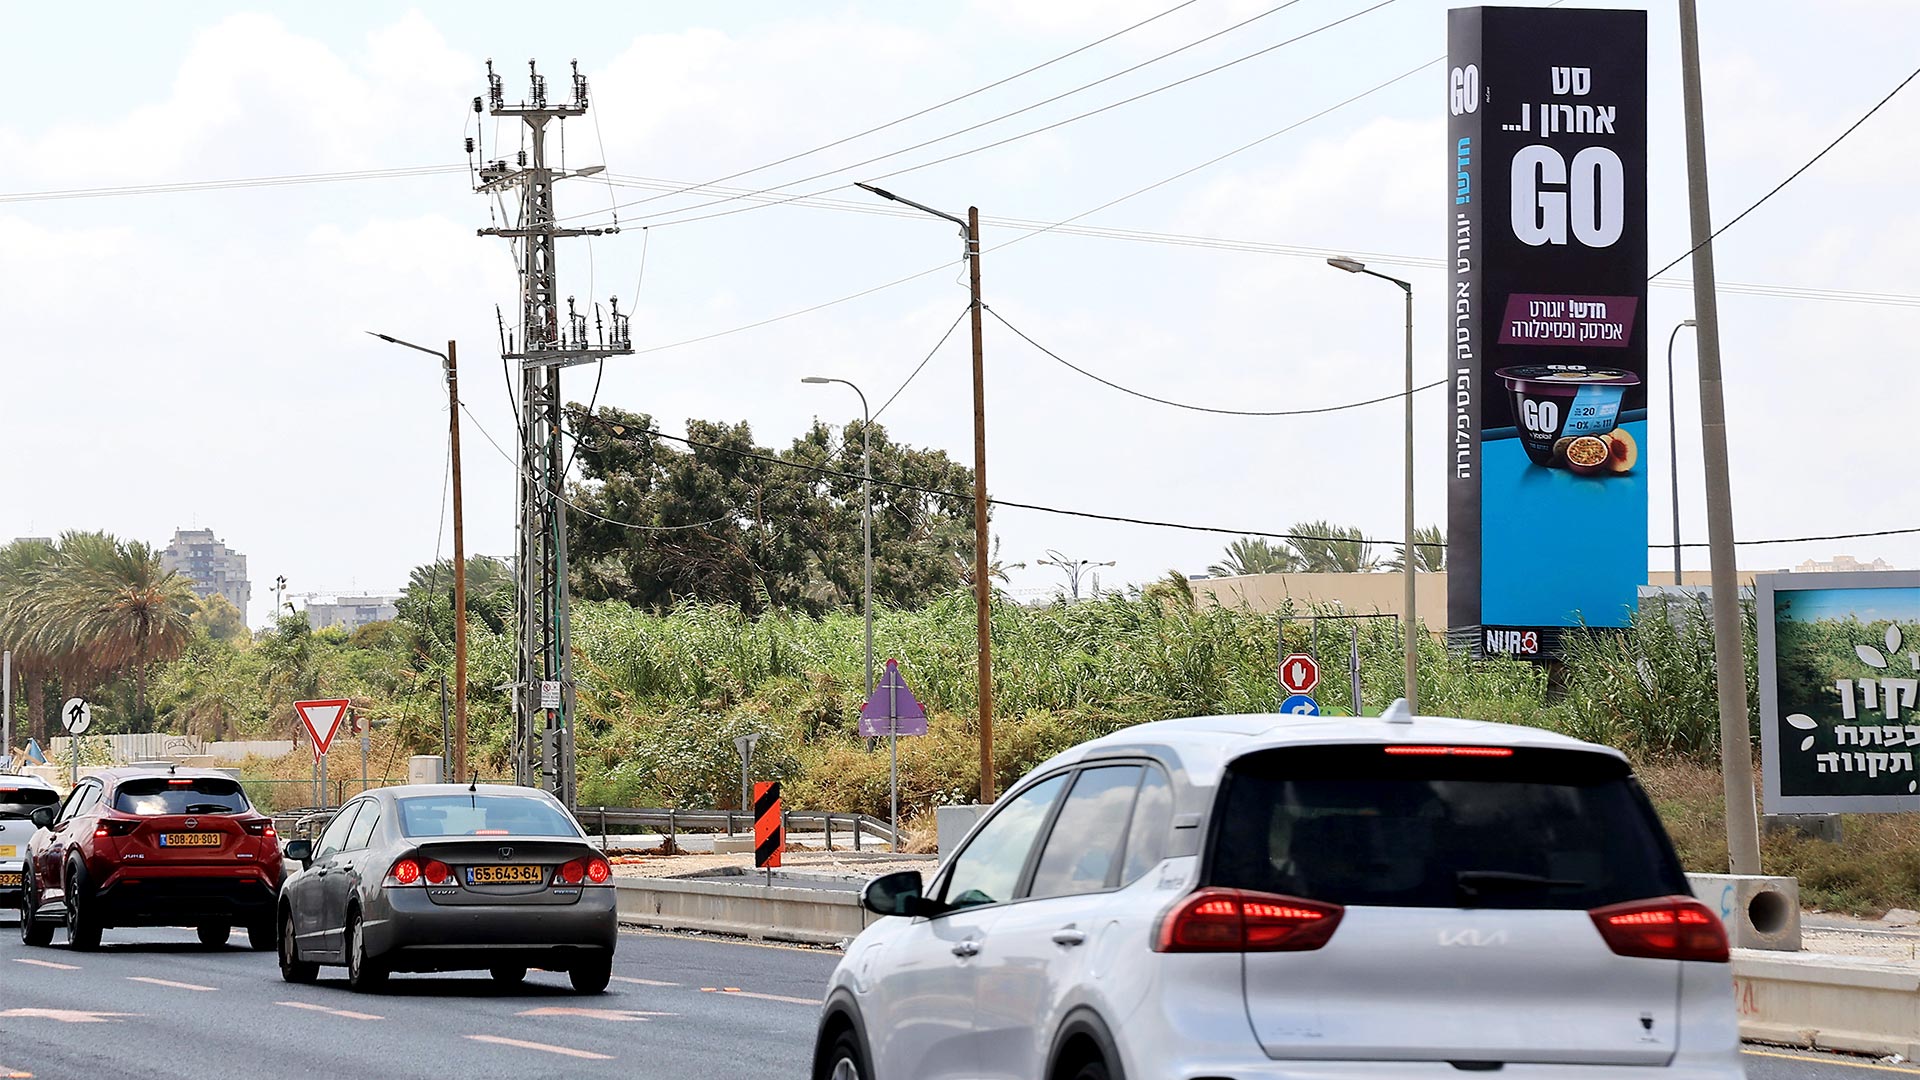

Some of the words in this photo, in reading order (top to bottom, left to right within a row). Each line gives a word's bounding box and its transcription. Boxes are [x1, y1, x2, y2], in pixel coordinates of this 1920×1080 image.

[1451, 64, 1478, 116] GO
[1551, 66, 1591, 96] סט
[1540, 104, 1616, 138] אחרון
[1456, 137, 1471, 205] חדש!
[1510, 144, 1624, 248] GO
[1457, 213, 1471, 274] יוגורט
[1457, 281, 1473, 360] אפרסק
[1528, 300, 1566, 318] יוגורט
[1568, 299, 1607, 319] חדש!
[1511, 319, 1576, 340] ופסיפלורה
[1579, 323, 1623, 342] אפרסק
[1455, 368, 1471, 479] ופסיפלורה
[1523, 399, 1559, 433] GO
[1582, 407, 1596, 416] 20
[1816, 751, 1914, 778] תקווה
